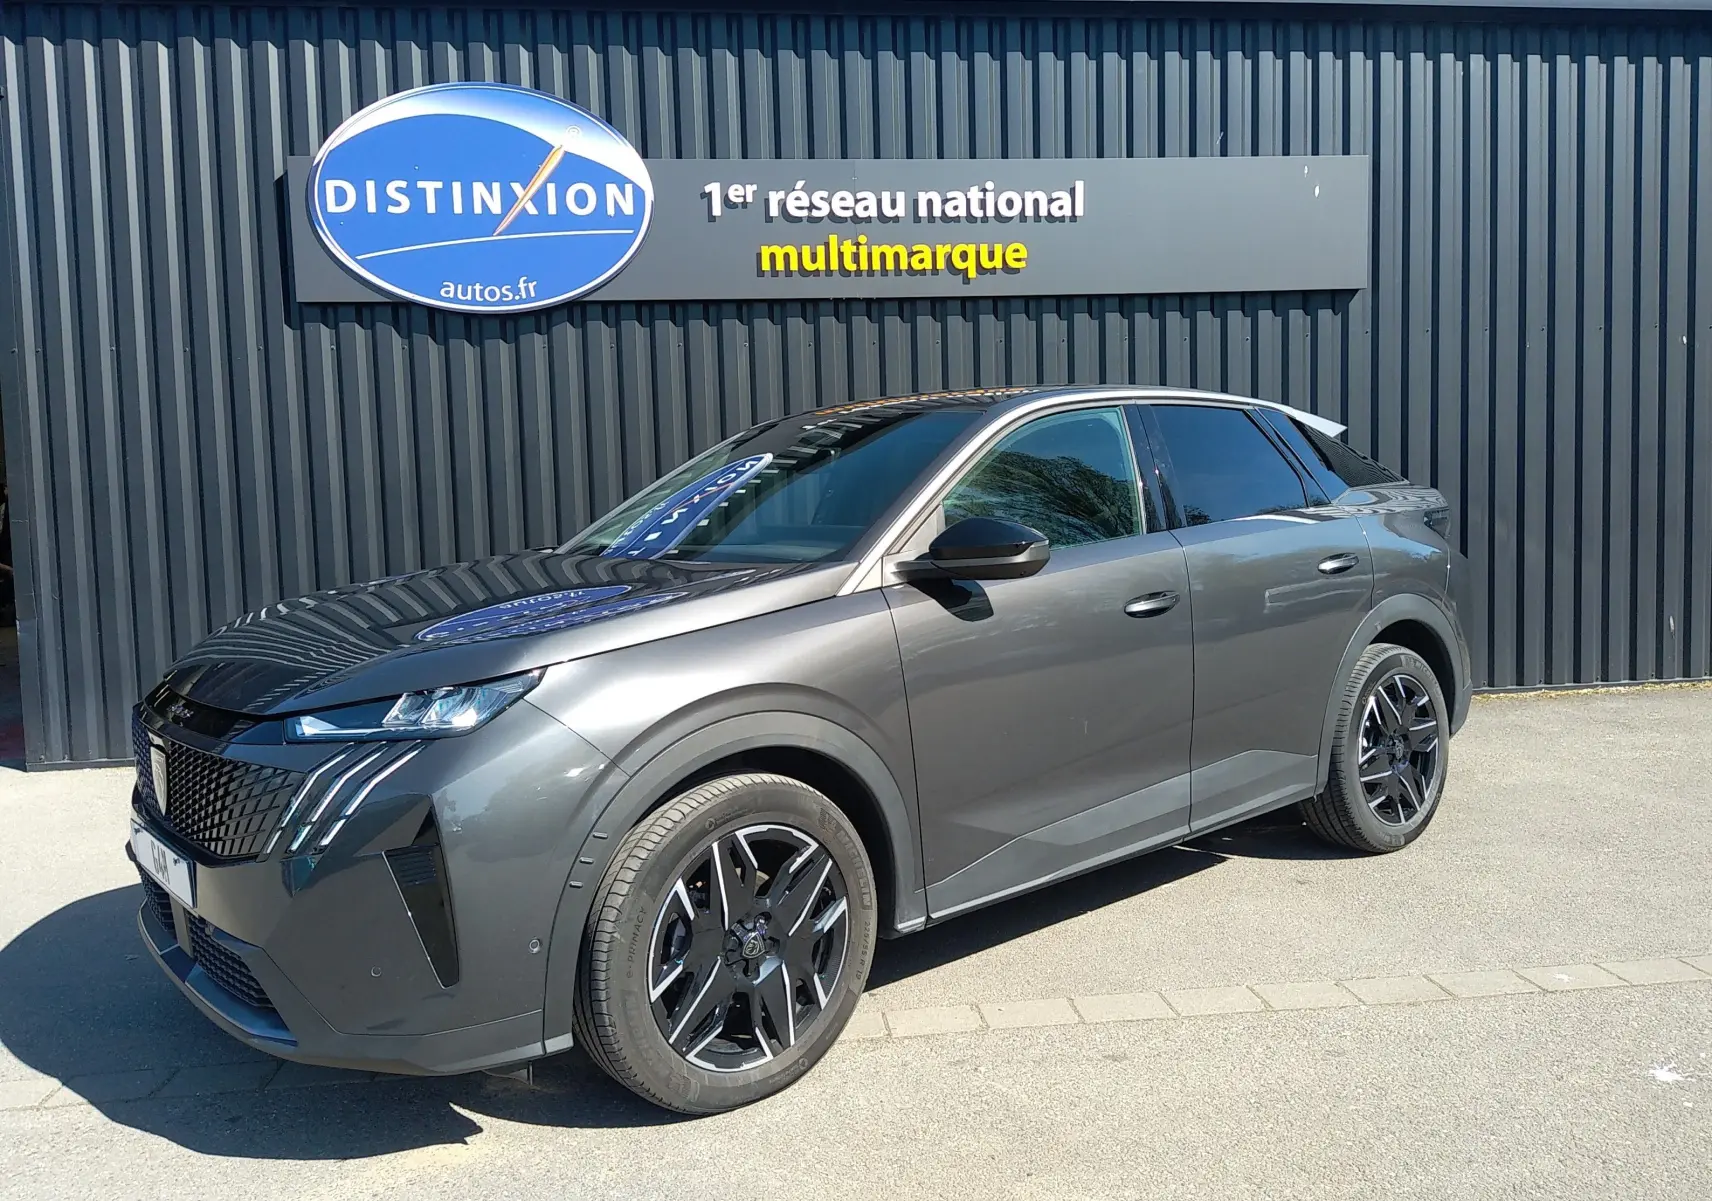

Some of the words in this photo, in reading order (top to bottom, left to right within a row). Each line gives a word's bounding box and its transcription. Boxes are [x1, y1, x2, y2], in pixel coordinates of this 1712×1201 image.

[325, 179, 634, 216] DISTINXION
[702, 182, 758, 216] 1er
[768, 180, 905, 218] réseau
[917, 180, 1085, 217] national
[760, 234, 1028, 279] multimarque
[439, 276, 537, 301] autos.fr
